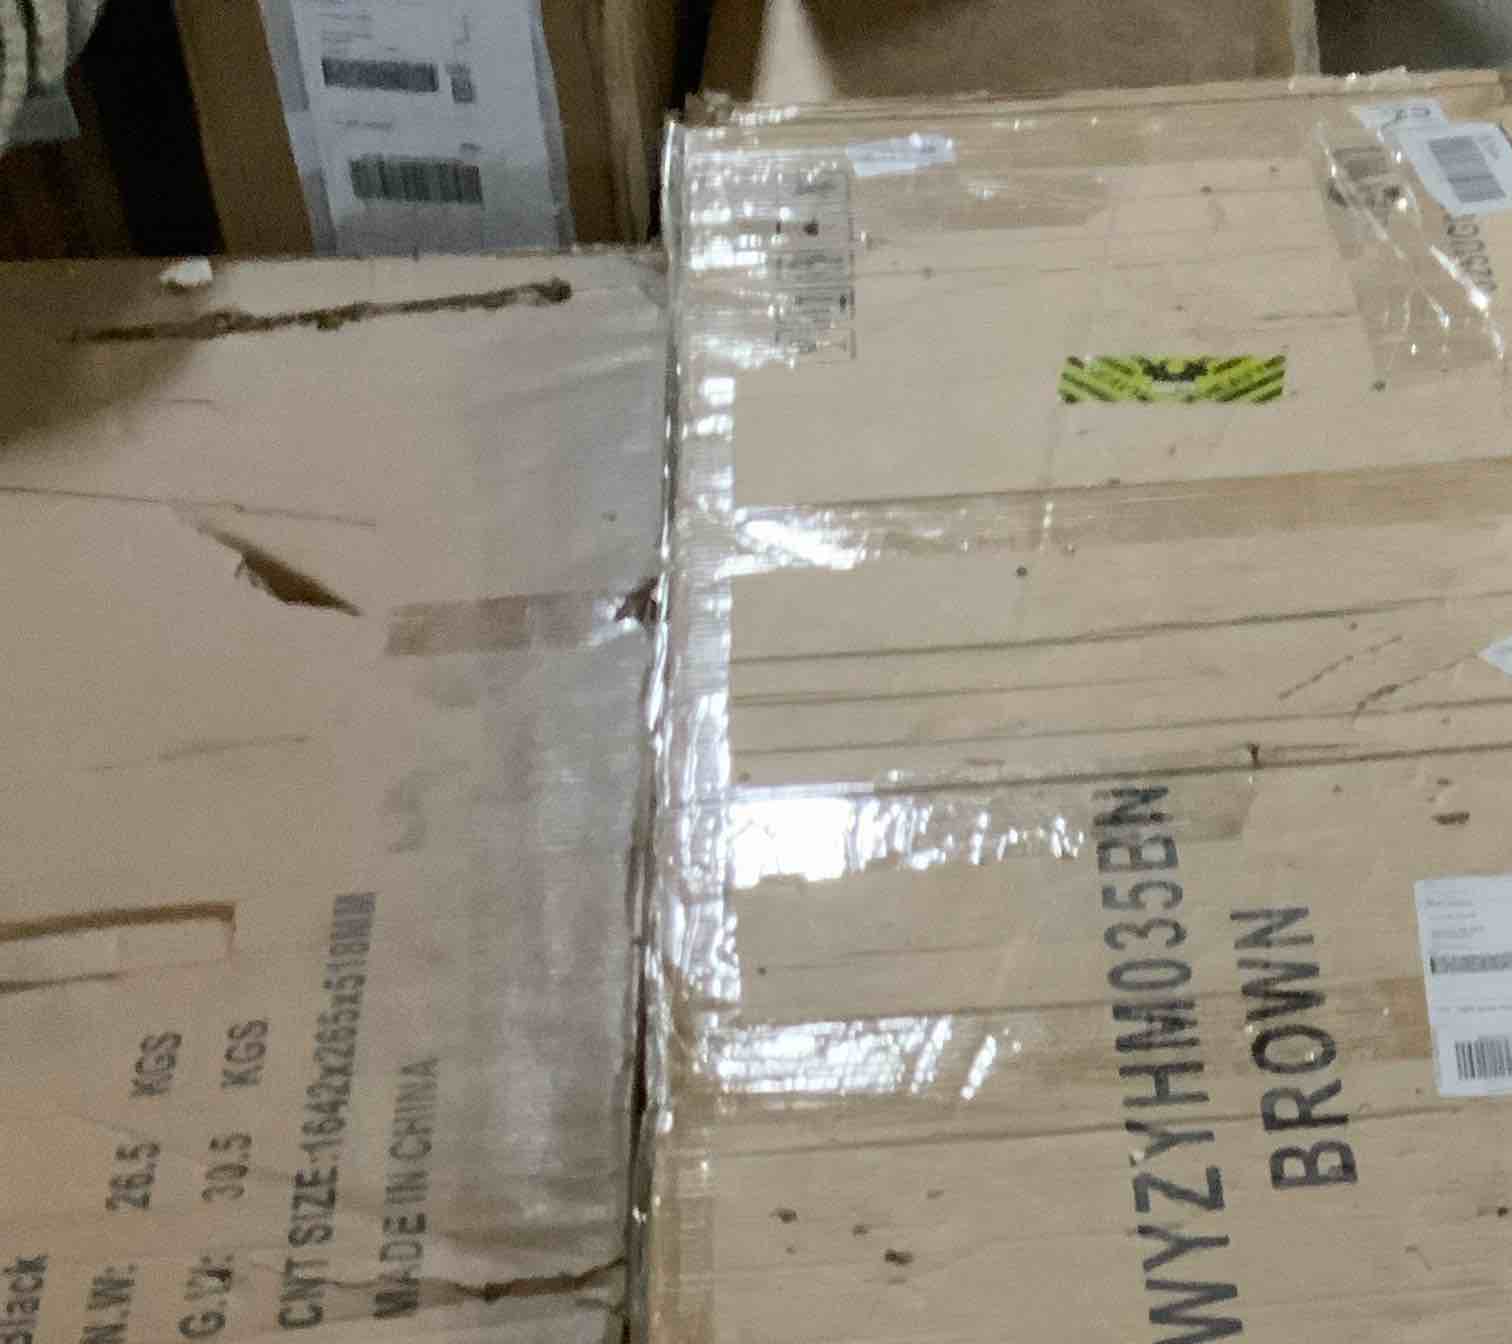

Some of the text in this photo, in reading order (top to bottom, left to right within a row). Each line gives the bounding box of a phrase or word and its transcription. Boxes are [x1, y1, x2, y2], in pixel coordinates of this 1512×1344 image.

[128, 1030, 183, 1099] KGS
[219, 1017, 270, 1092] KGS
[1229, 904, 1358, 1191] BROWN
[104, 1140, 160, 1211] 26.5
[372, 1056, 440, 1320] MADE IN CHINA
